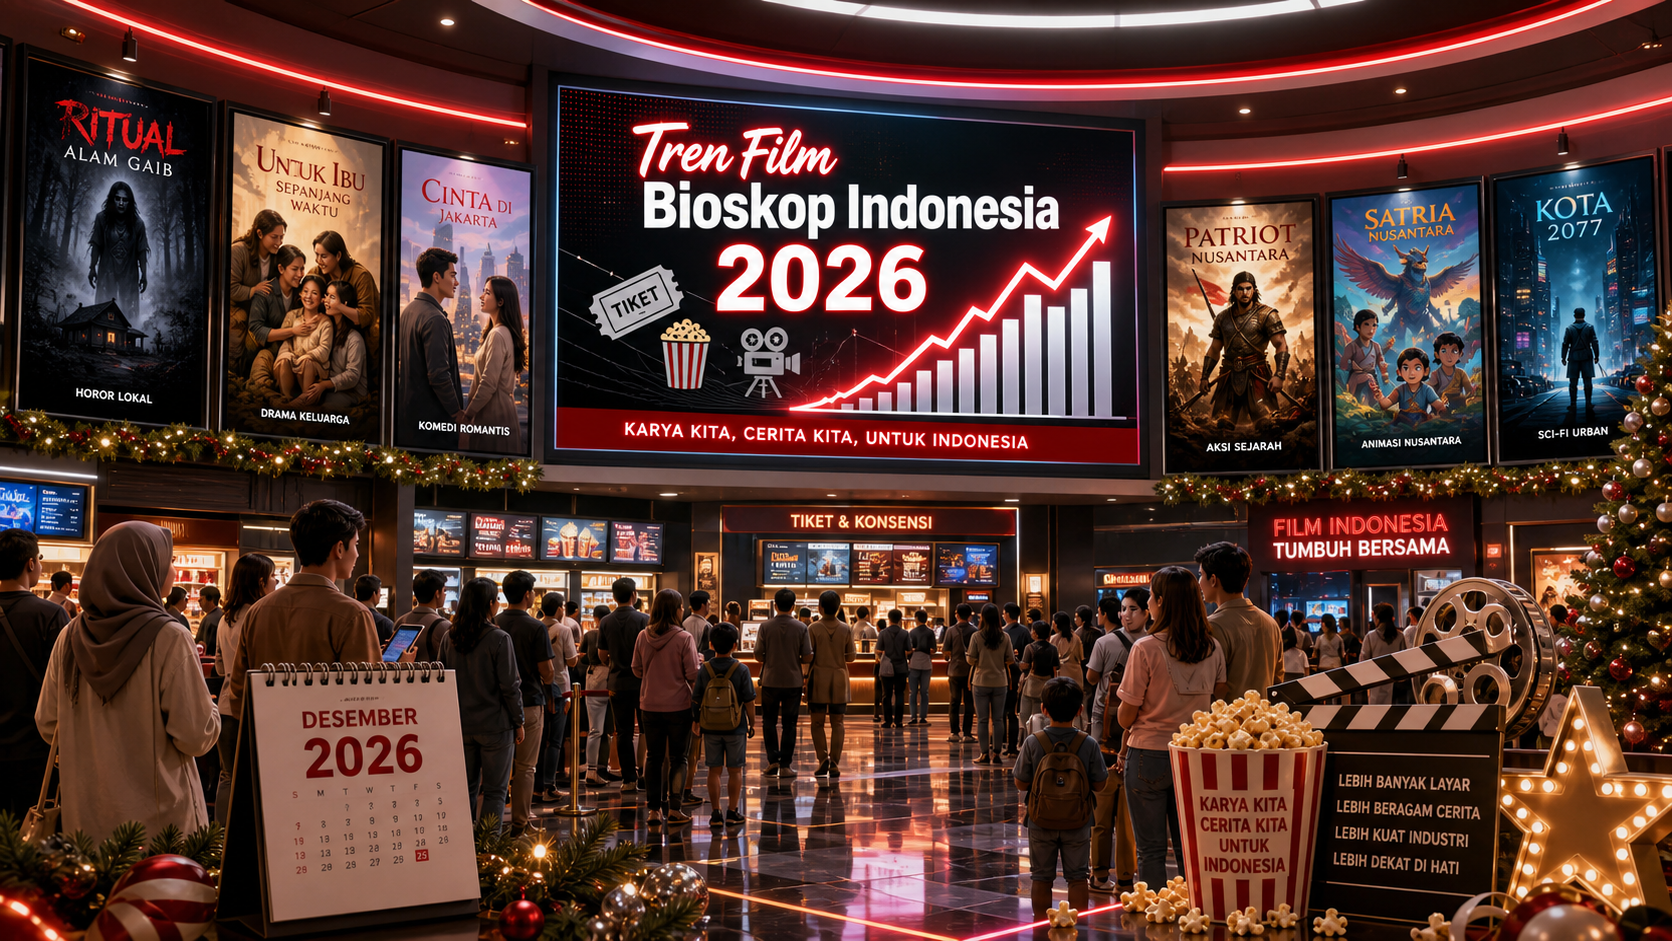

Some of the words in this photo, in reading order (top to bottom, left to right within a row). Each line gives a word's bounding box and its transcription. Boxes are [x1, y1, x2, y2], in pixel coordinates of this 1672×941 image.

[64, 145, 118, 167] ALAM
[128, 156, 172, 177] GAIB
[632, 121, 735, 178] Tren
[740, 126, 838, 181] Film
[332, 162, 365, 191] IBU
[276, 180, 350, 205] SEPANJANG
[422, 178, 492, 211] CINTA
[498, 200, 511, 214] DI
[291, 199, 338, 217] WAKTU
[643, 180, 836, 239] Bioskop
[848, 184, 1060, 229] Indonesia
[1365, 203, 1456, 230] SATRIA
[1536, 191, 1613, 222] KOTA
[439, 209, 497, 228] JAKARTA
[1184, 224, 1296, 248] PATRIOT
[1369, 224, 1454, 242] NUSANTARA
[1548, 219, 1602, 241] 2077
[1192, 248, 1289, 264] NUSANTARA
[716, 244, 927, 312] 2026
[611, 285, 658, 318] TIKET
[76, 388, 114, 400] HOROR
[118, 391, 153, 404] LOKAL
[261, 408, 296, 420] DRAMA
[300, 411, 350, 425] KELUARGA
[419, 421, 457, 432] KOMEDI
[460, 424, 510, 436] ROMANTIS
[624, 422, 684, 438] KARYA
[691, 425, 736, 442] KITA,
[743, 427, 806, 442] CERITA
[814, 429, 858, 447] KITA,
[866, 431, 926, 446] UNTUK
[933, 433, 1028, 449] INDONESIA
[1538, 429, 1568, 439] SCI-FI
[1573, 426, 1608, 437] URBAN
[1206, 442, 1231, 452] AKSI
[1234, 442, 1282, 451] SEJARAH
[1361, 439, 1401, 449] ANIMASI
[1404, 436, 1461, 447] NUSANTARA
[791, 514, 834, 528] TIKET
[838, 515, 849, 528] &
[855, 515, 932, 529] KONSENSI
[1273, 518, 1322, 537] FILM
[1330, 513, 1448, 535] INDONESIA
[1273, 540, 1351, 559] TUMBUH
[1358, 537, 1450, 557] BERSAMA
[302, 708, 418, 729] DESEMBER
[304, 734, 423, 779] 2026
[292, 791, 298, 799] S
[317, 789, 325, 797] M
[342, 787, 348, 796] T
[366, 786, 374, 794] W
[390, 784, 395, 792] T
[436, 782, 441, 790] S
[1339, 774, 1372, 787] LEBIH
[1376, 775, 1426, 790] BANYAK
[1430, 777, 1470, 792] LAYAR
[1200, 796, 1249, 812] KARYA
[1254, 797, 1287, 812] KITA
[1336, 800, 1370, 814] LEBIH
[1374, 801, 1432, 817] BERAGAM
[1436, 805, 1480, 820] CERITA
[1201, 817, 1251, 833] CERITA
[1256, 817, 1287, 833] KITA
[1219, 838, 1269, 853] UNTUK
[1335, 826, 1369, 840] LEBIH
[1373, 828, 1405, 843] KUAT
[1409, 830, 1469, 848] INDUSTRI
[1204, 856, 1285, 873] INDONESIA
[1333, 852, 1367, 867] LEBIH
[1371, 855, 1411, 871] DEKAT
[1414, 859, 1426, 872] DI
[1431, 860, 1459, 875] HATI
